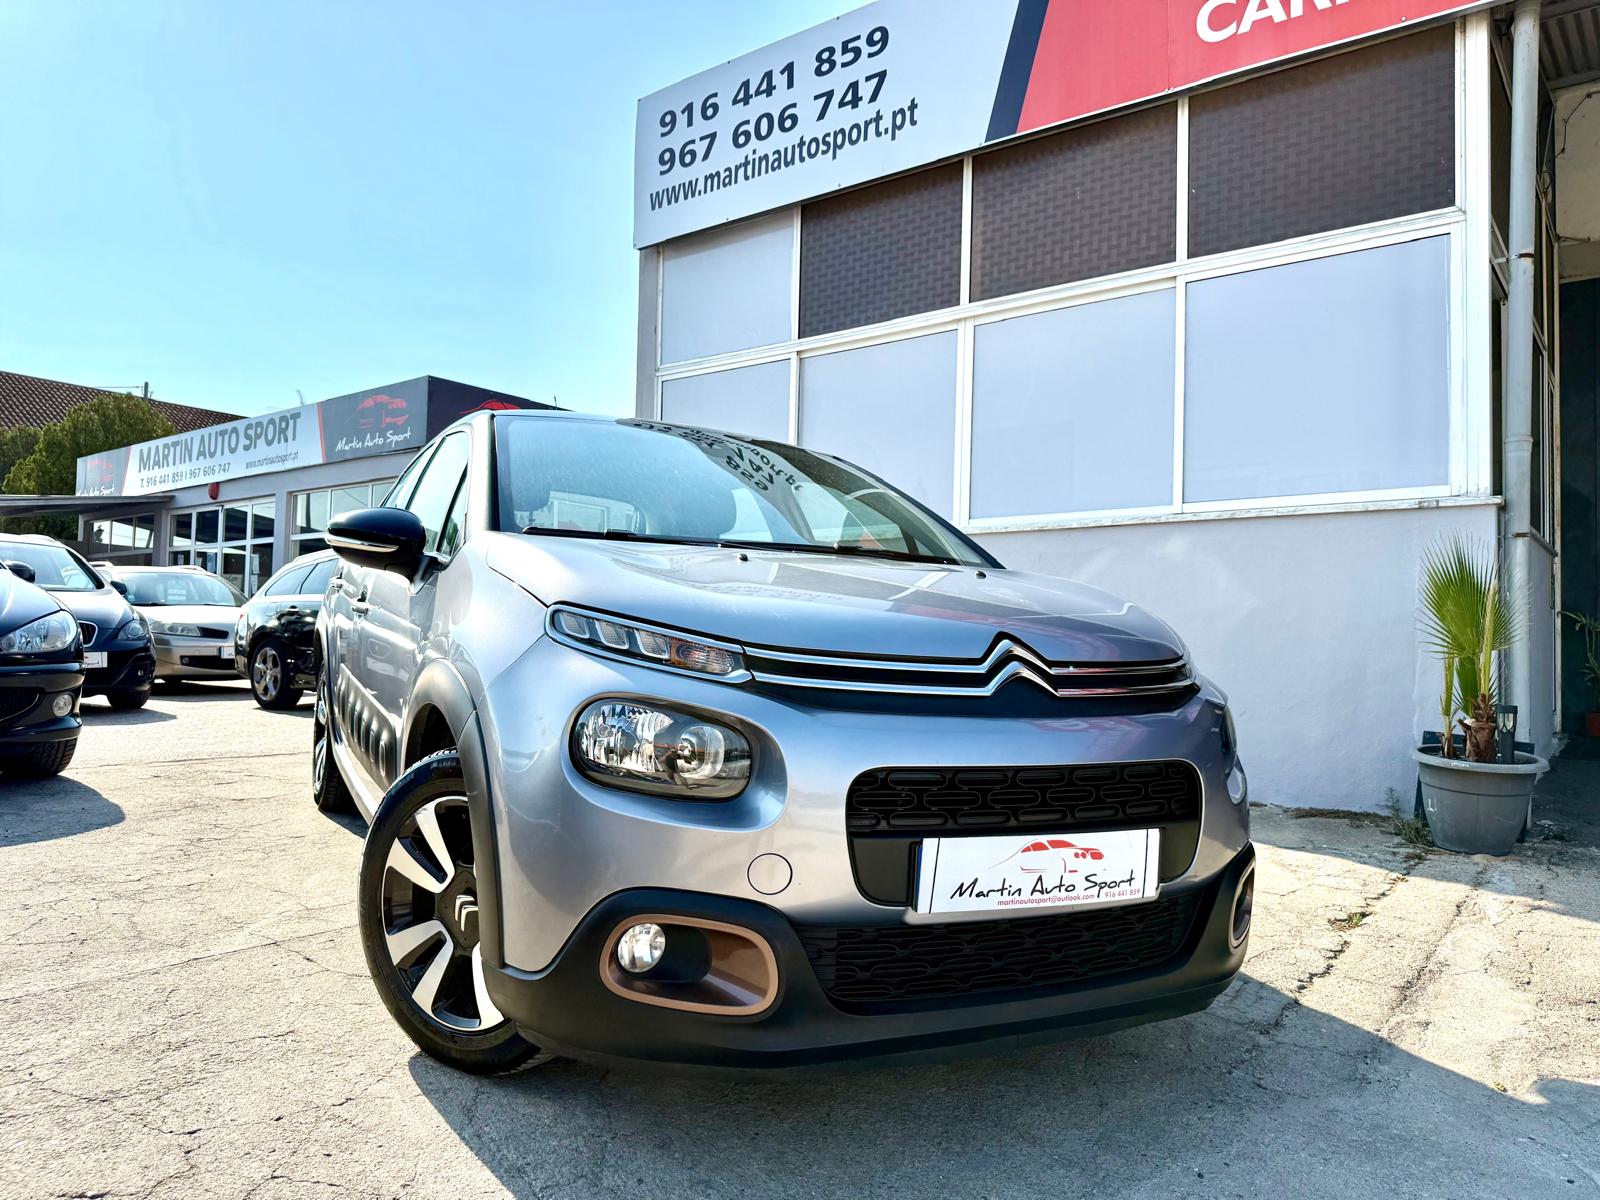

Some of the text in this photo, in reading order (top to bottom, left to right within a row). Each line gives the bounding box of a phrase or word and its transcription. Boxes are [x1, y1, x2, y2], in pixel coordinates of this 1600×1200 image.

[659, 25, 890, 138] 916 441 859
[658, 69, 888, 176] 967 606 747
[649, 97, 919, 211] www.martinautosport.pt
[138, 412, 301, 473] MARTIN AUTO SPORT
[336, 426, 412, 452] Martin Auto Sport
[146, 476, 157, 487] 916
[159, 473, 170, 485] 441
[171, 471, 183, 483] 859
[188, 467, 201, 479] 967
[203, 464, 216, 476] 606
[217, 462, 231, 474] 747
[245, 450, 299, 470] www.martinautosport.pt
[950, 869, 1136, 899] Martin Auto Sport
[997, 888, 1141, 906] martinautosport@outlook.com 916 441 859
